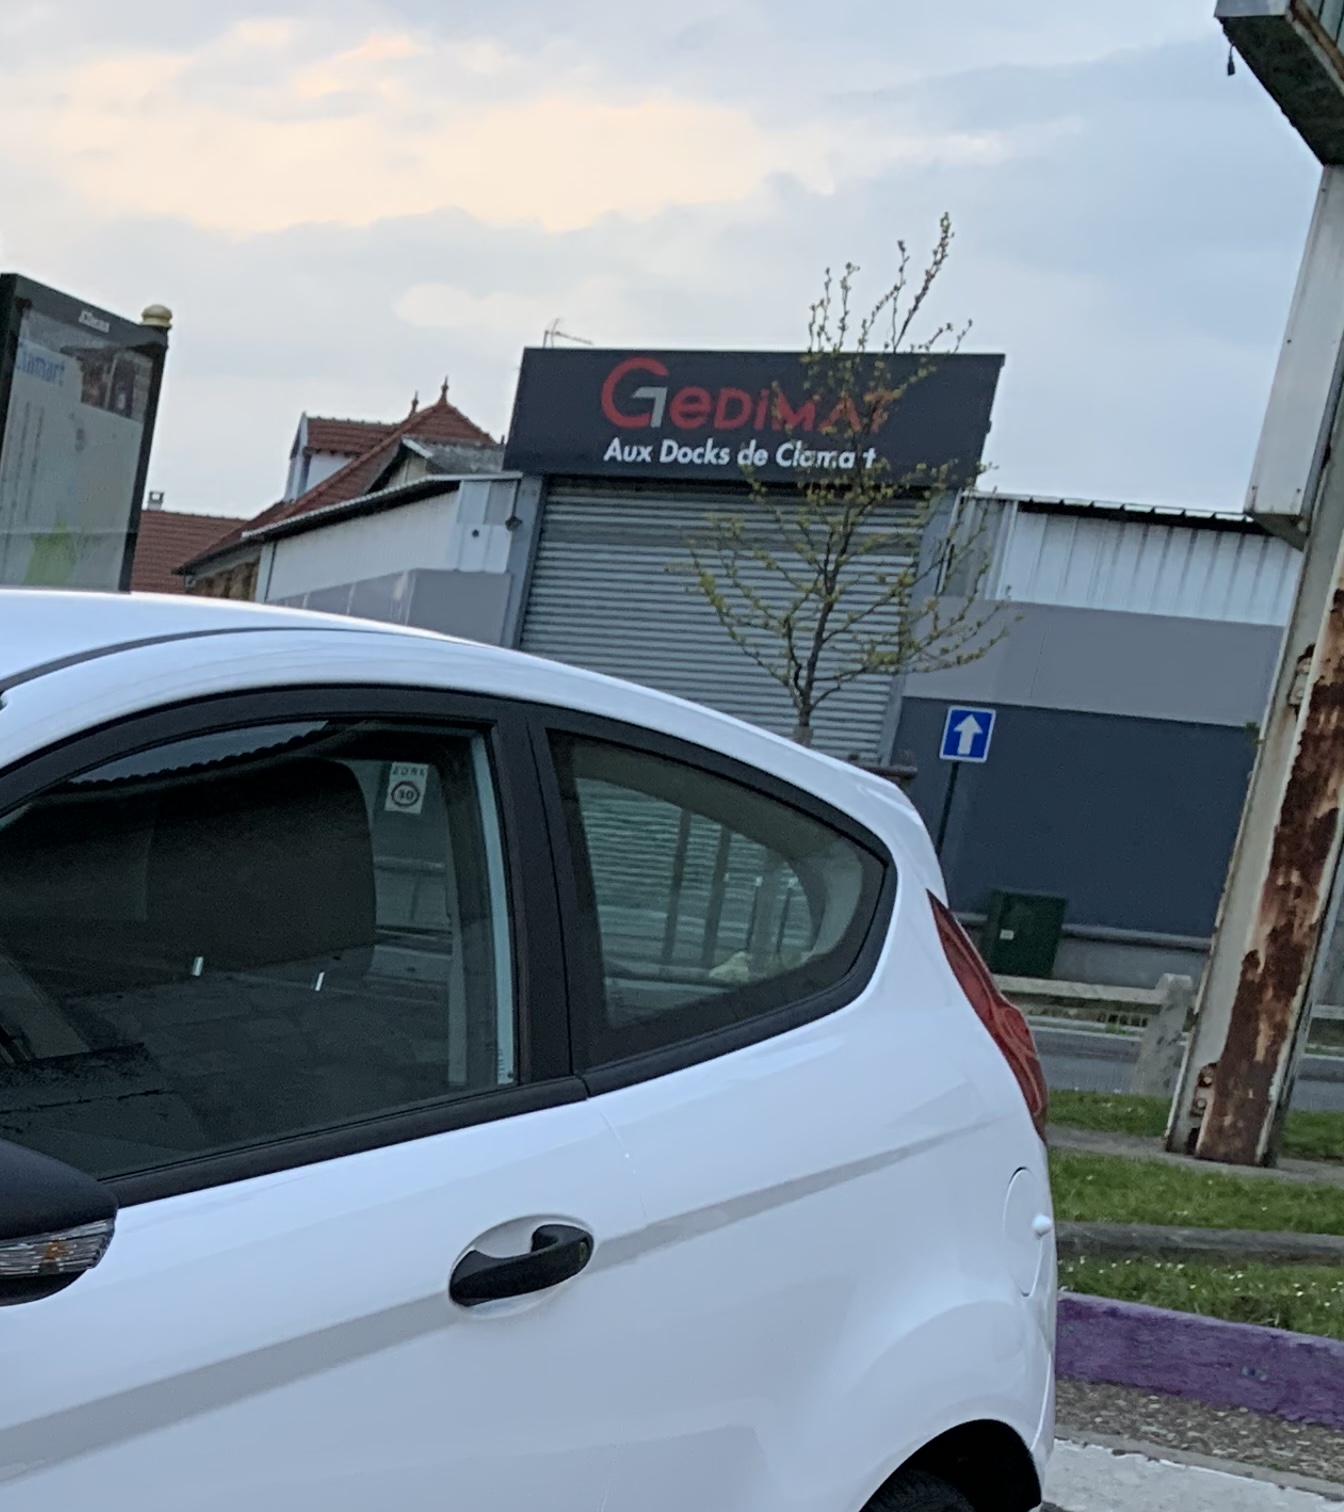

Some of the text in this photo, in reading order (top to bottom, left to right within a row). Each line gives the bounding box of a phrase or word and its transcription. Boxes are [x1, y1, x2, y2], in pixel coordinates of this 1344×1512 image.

[603, 437, 876, 469] Aux Docks de Clamat
